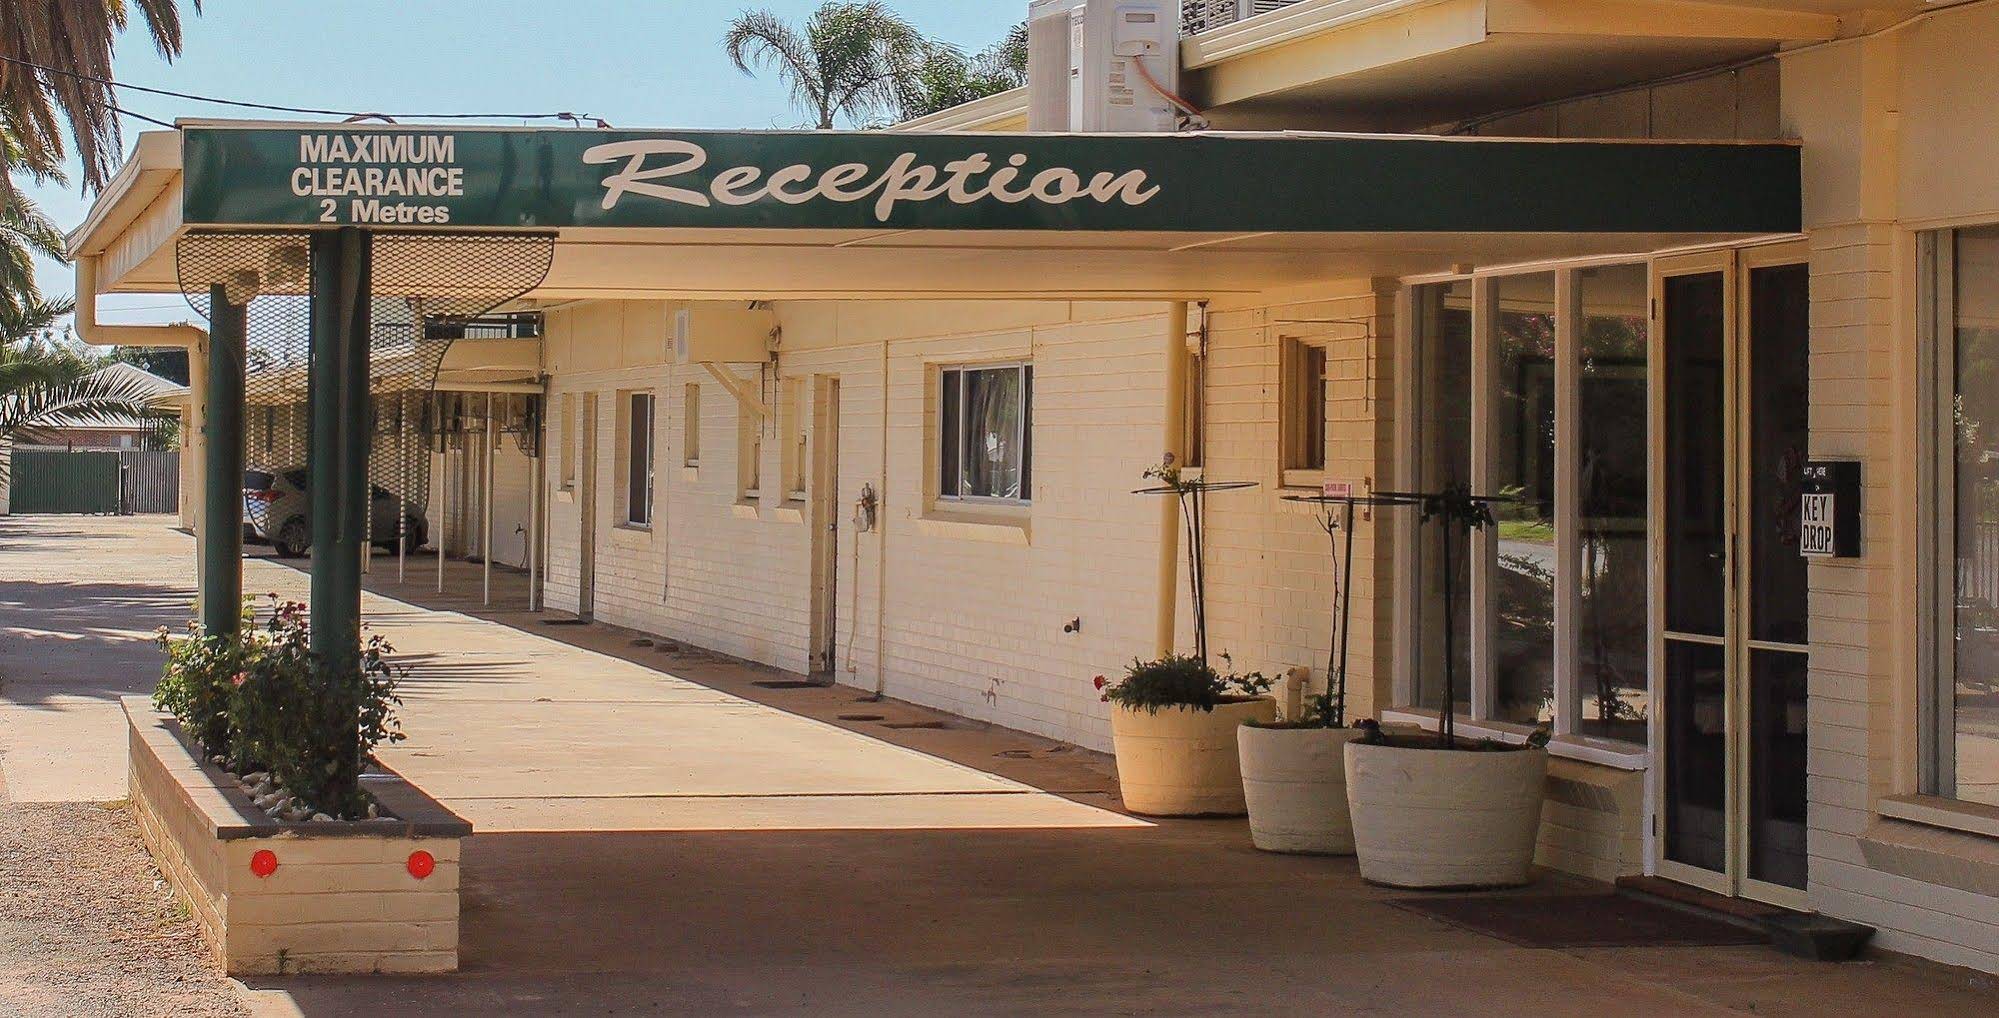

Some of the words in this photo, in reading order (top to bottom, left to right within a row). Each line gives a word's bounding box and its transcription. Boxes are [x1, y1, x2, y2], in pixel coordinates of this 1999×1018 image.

[300, 134, 455, 163] MAXIMUM
[292, 168, 464, 197] CLEARANCE
[582, 138, 1161, 222] Reception
[320, 199, 337, 222] 2
[351, 199, 450, 224] Metres
[1803, 496, 1827, 521] KEY
[1803, 525, 1831, 551] DROP
